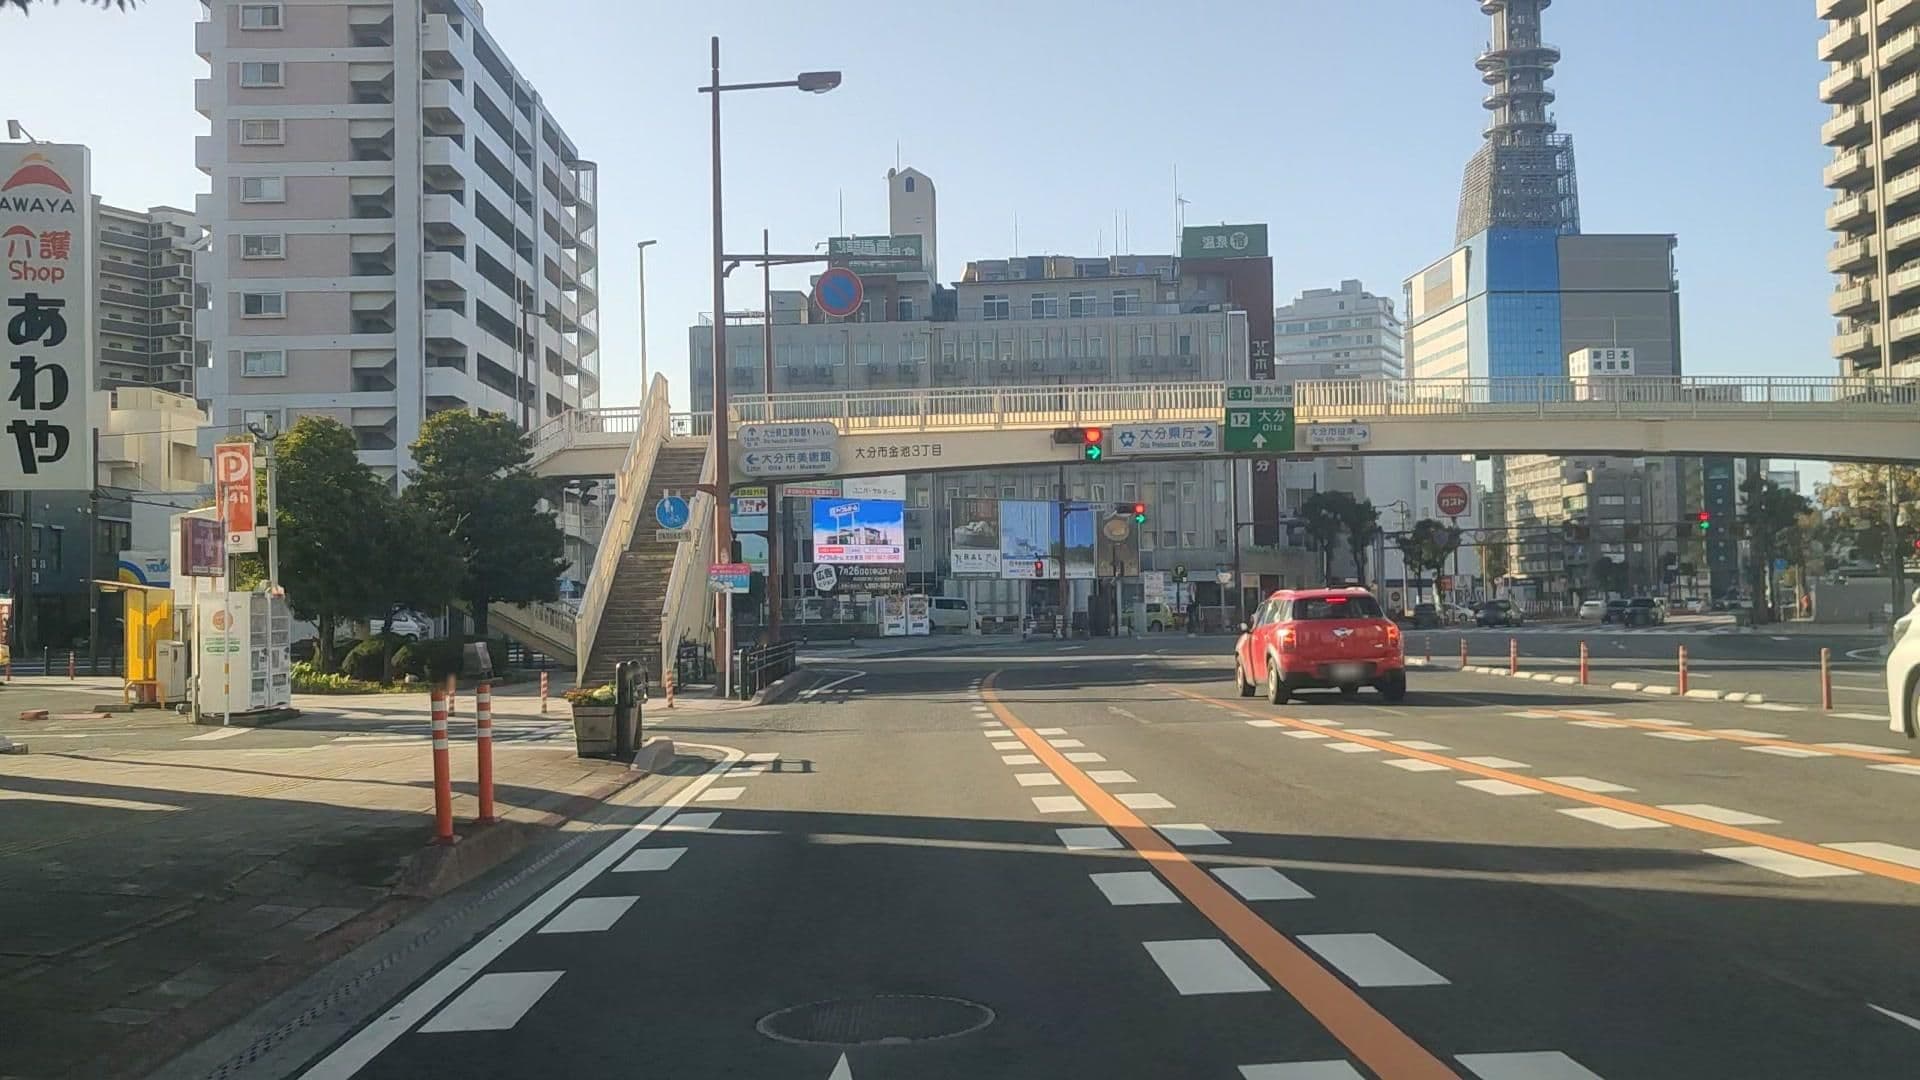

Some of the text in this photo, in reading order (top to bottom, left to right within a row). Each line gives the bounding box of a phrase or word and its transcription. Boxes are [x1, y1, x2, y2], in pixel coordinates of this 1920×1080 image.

[0, 197, 75, 213] AWAYA
[9, 260, 65, 284] Shop
[7, 292, 69, 474] あわや
[1232, 414, 1248, 425] 12
[1258, 409, 1287, 422] 大分
[1141, 427, 1195, 440] 大分県庁
[1262, 423, 1282, 431] Oita
[762, 451, 831, 464] 大分市美術館
[855, 444, 941, 458] 大分市金池3丁目
[218, 451, 249, 482] P
